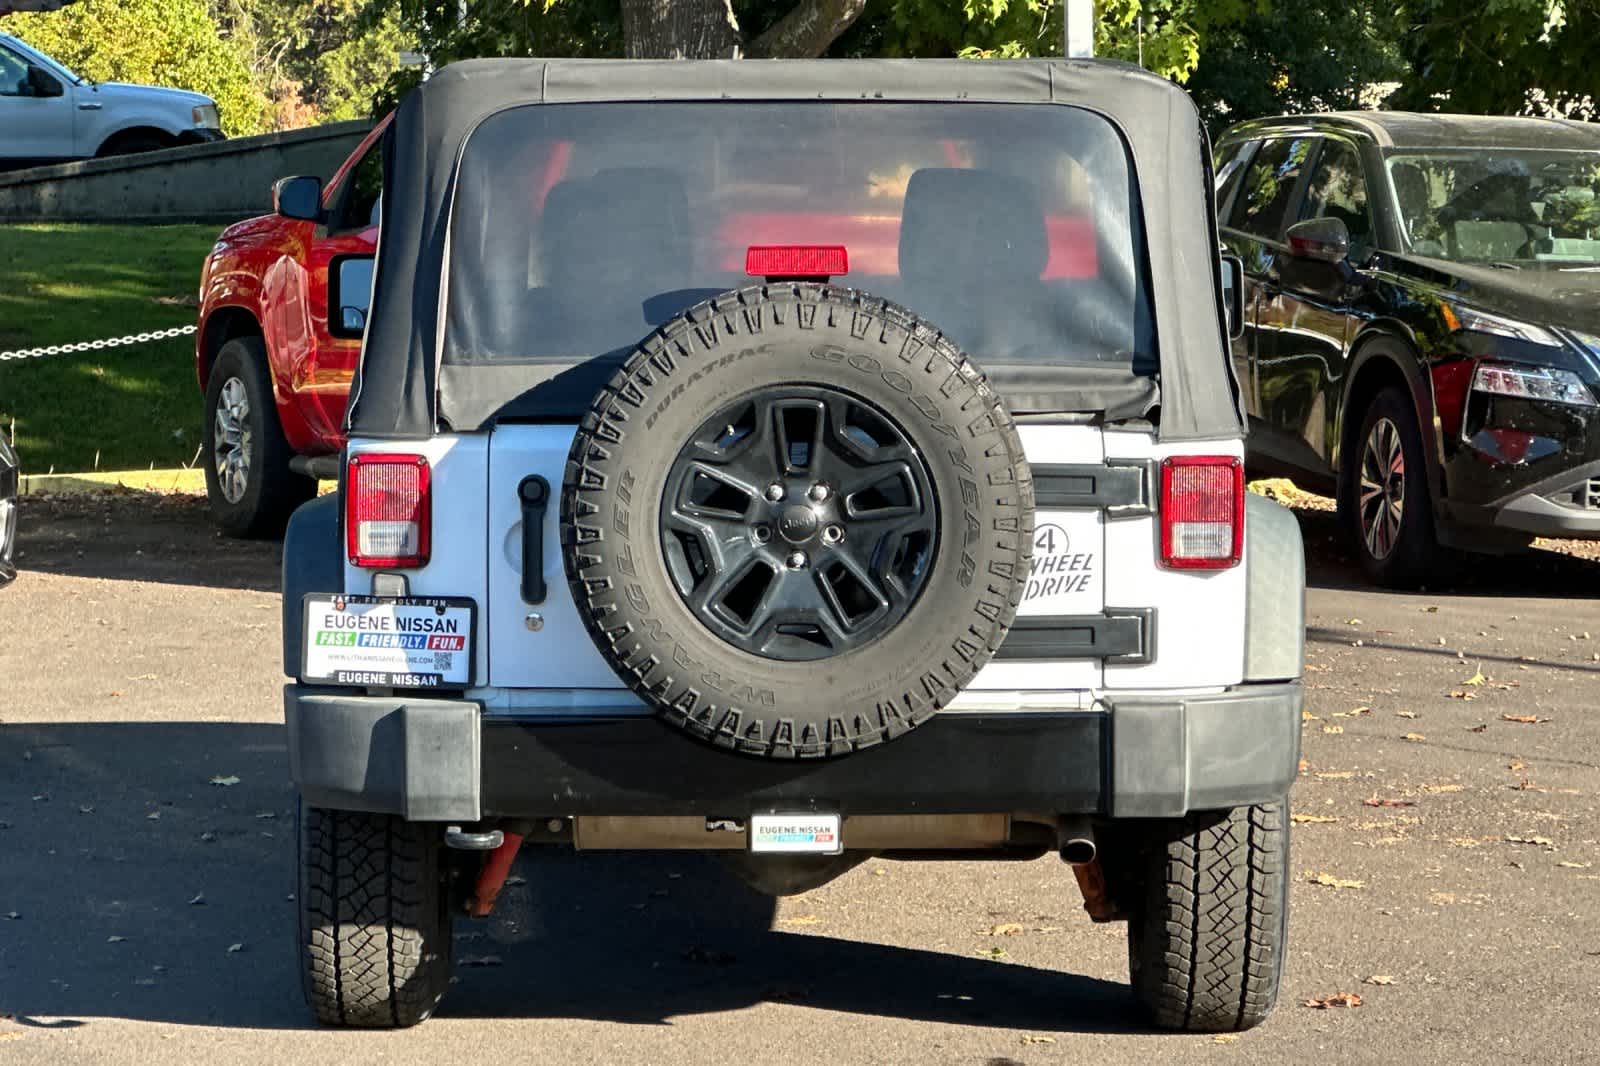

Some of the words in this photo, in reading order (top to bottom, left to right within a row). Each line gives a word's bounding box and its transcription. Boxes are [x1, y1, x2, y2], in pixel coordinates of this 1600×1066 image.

[646, 344, 776, 430] DURATRAC
[810, 345, 981, 588] GOODYEAR
[1035, 528, 1056, 553] 4
[613, 467, 776, 706] WRANGLER
[1025, 575, 1092, 600] DRIVE
[325, 615, 390, 630] EUGENE
[396, 617, 457, 633] NISSAN
[320, 633, 353, 646] FAST.
[362, 635, 423, 649] FRIENDLY.
[432, 637, 461, 650] FUN.
[338, 672, 387, 684] EUGENE
[392, 674, 438, 686] NISSAN
